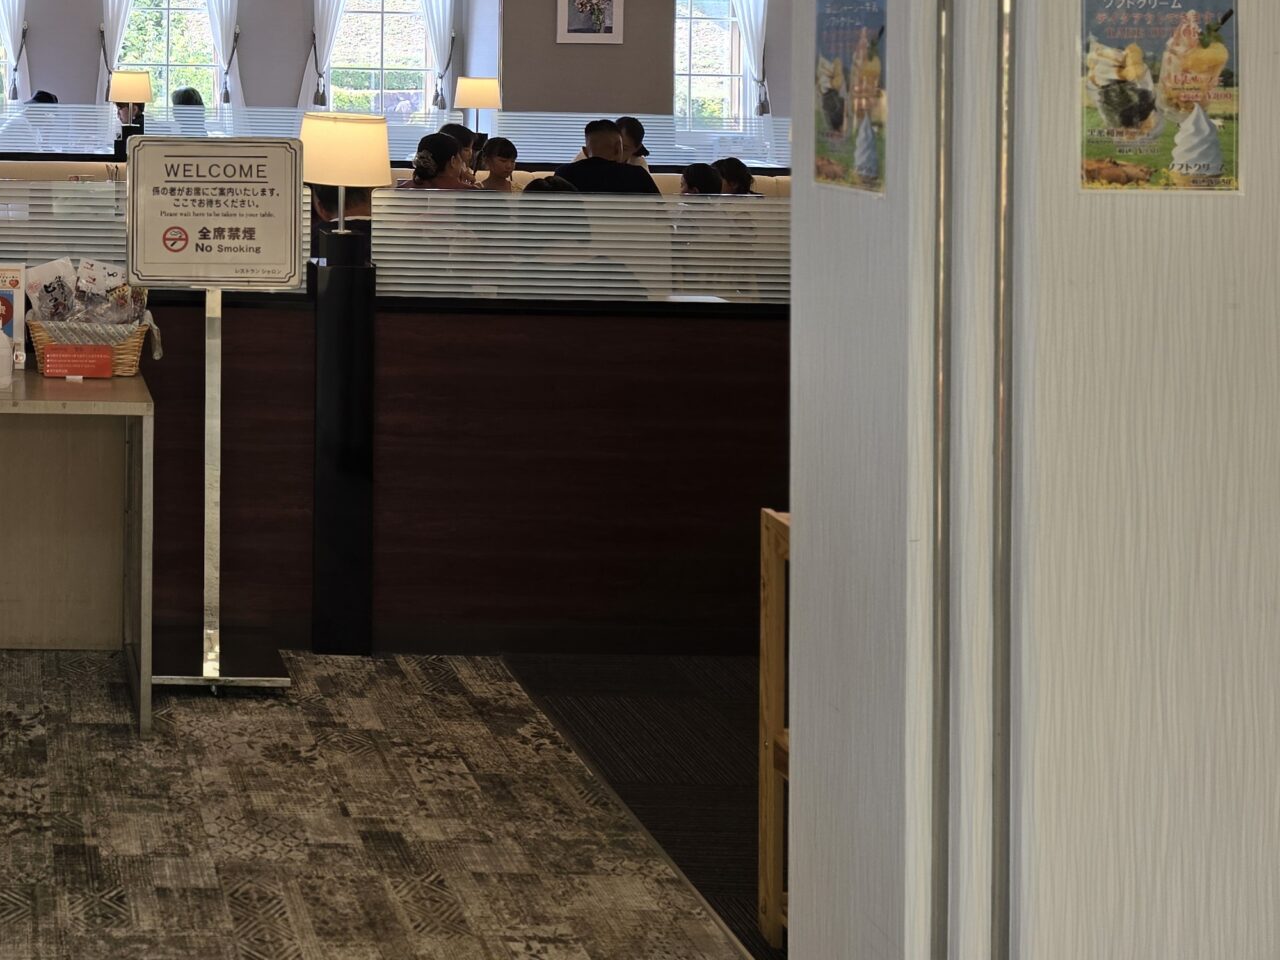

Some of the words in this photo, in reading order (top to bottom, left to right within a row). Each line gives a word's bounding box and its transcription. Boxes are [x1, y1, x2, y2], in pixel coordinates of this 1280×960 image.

[164, 163, 268, 179] WELCOME
[173, 198, 259, 208] ここでお待ちください。
[198, 226, 256, 240] 全席禁煙
[195, 242, 213, 253] No
[217, 244, 262, 254] Smoking
